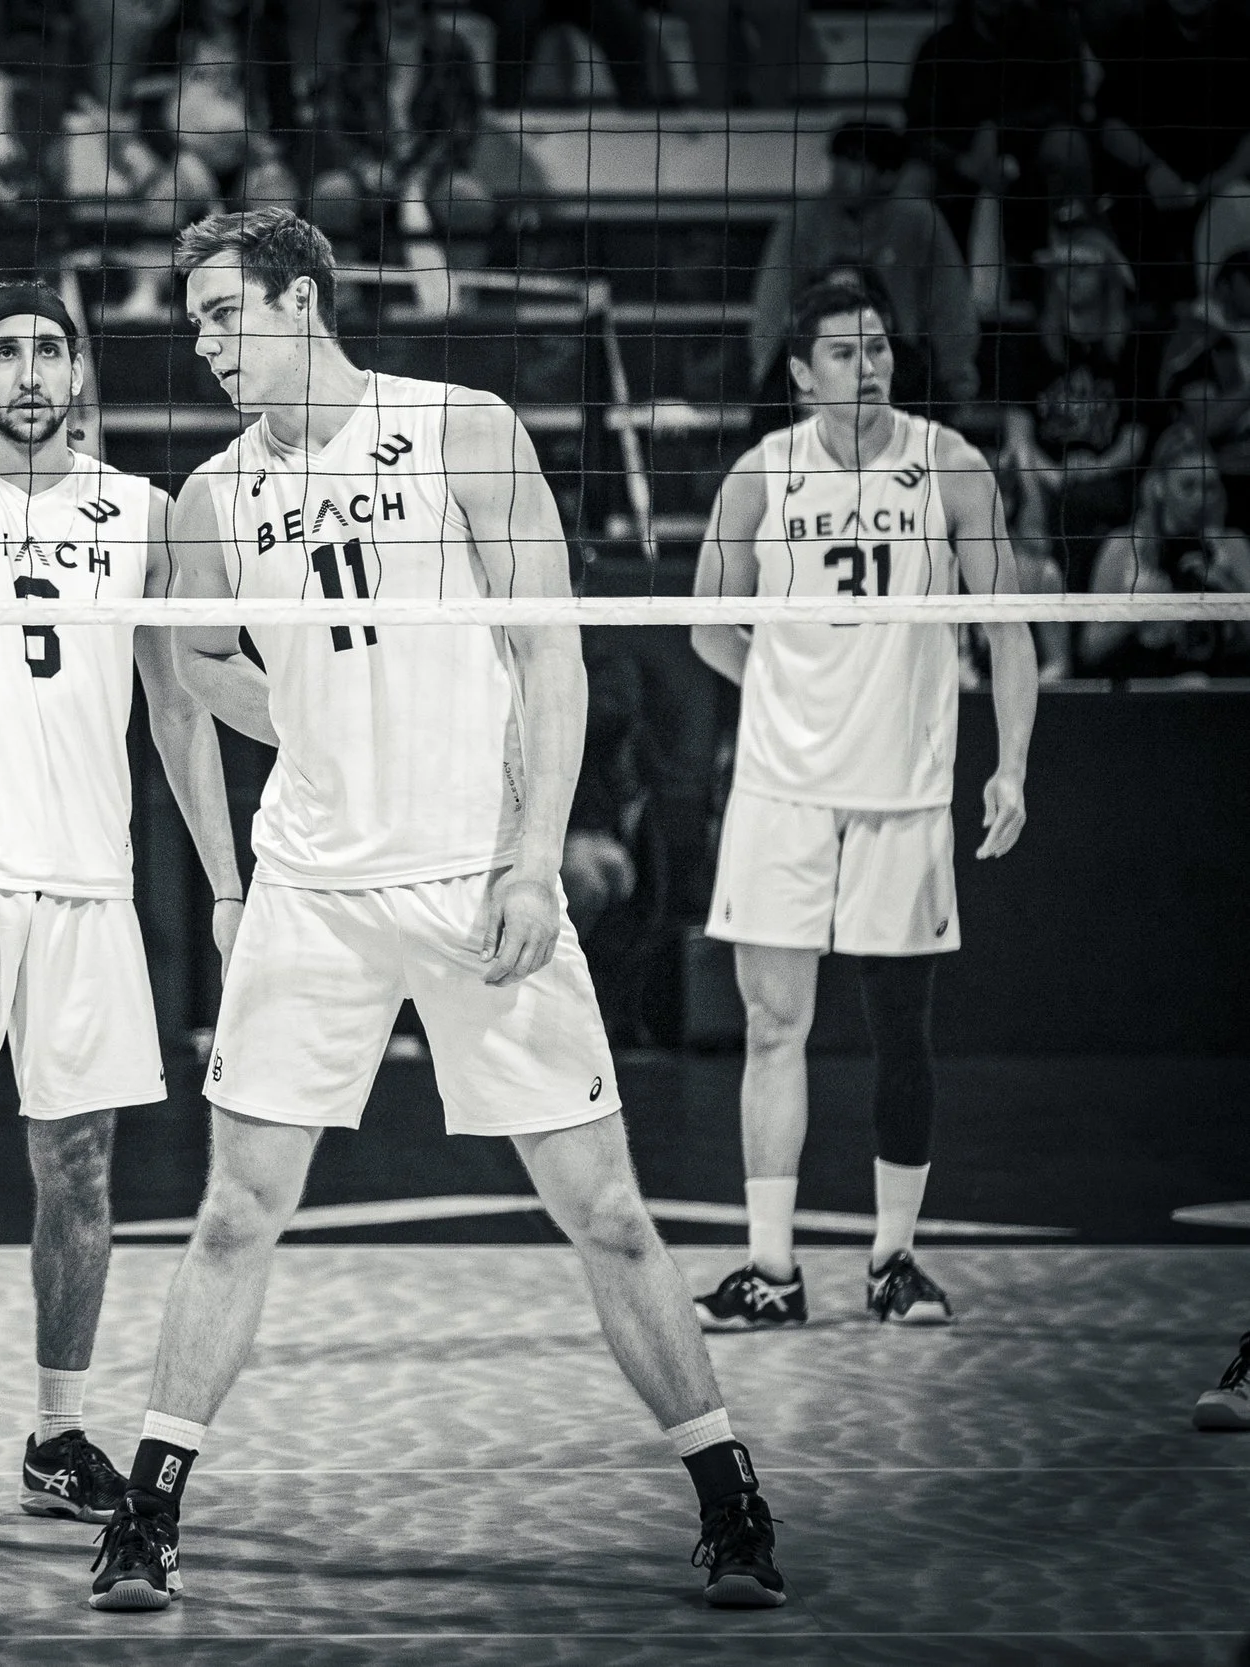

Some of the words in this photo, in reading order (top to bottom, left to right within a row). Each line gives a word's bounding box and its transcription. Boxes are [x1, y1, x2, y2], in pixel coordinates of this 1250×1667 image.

[258, 492, 406, 556] BEACH
[789, 509, 915, 539] BEACH
[311, 538, 378, 652] 11
[824, 543, 891, 627] 31
